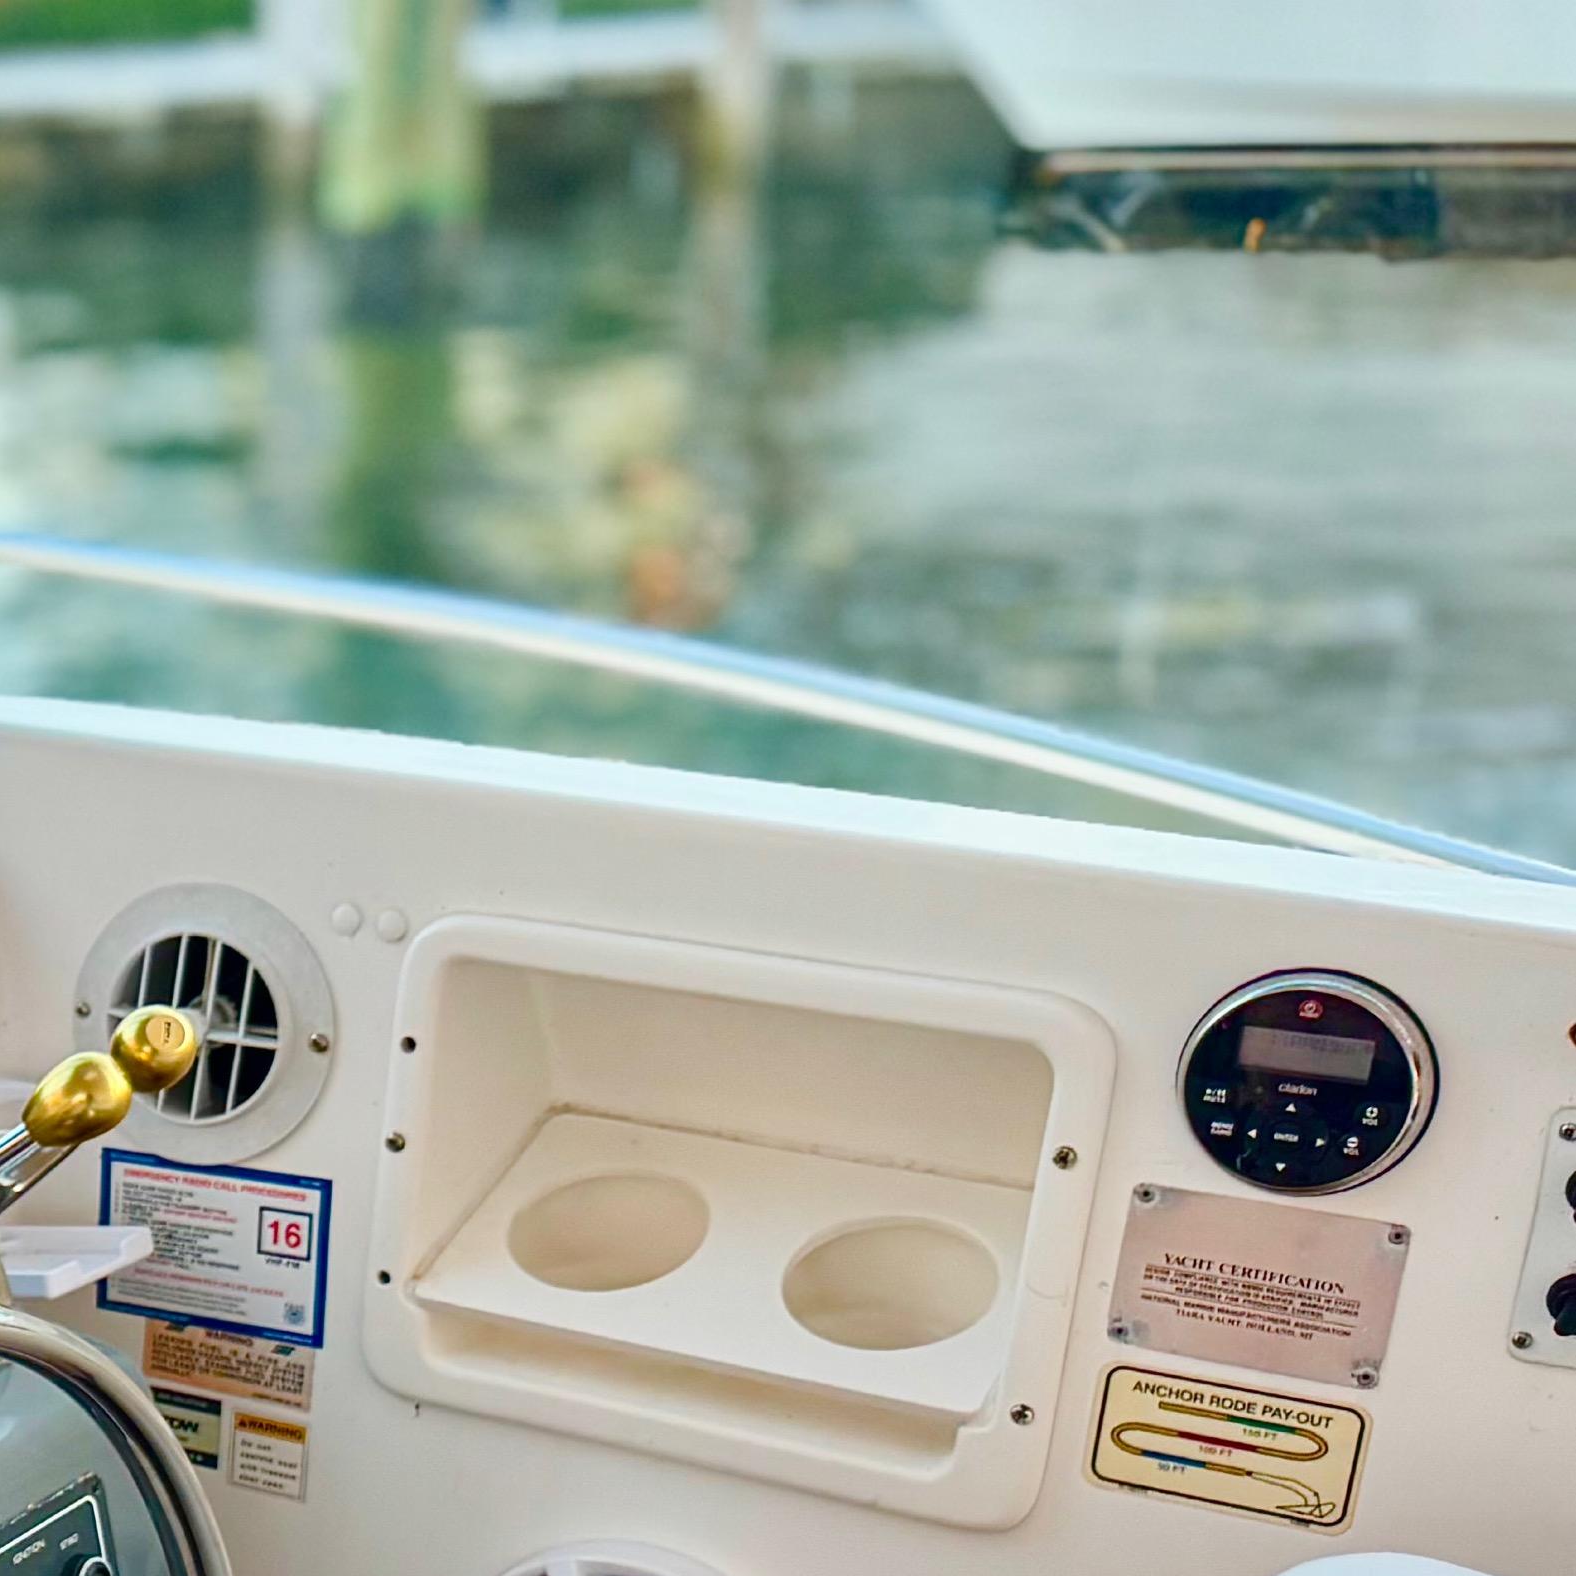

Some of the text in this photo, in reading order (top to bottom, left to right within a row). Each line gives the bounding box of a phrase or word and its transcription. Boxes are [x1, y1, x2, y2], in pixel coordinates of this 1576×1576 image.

[123, 1167, 181, 1185] EMERGENCY
[182, 1175, 212, 1190] RADIO
[213, 1181, 238, 1193] CALL
[240, 1184, 307, 1203] PROCEDURES
[268, 1219, 302, 1249] 16
[1164, 1253, 1345, 1295] YACHT CERTIFICATION
[1133, 1380, 1333, 1429] ANCHOR RODE PAY-OUT
[246, 1419, 303, 1440] WARNING
[1264, 1431, 1279, 1441] FT
[1219, 1448, 1233, 1458] FT
[1172, 1465, 1186, 1474] FT
[12, 1539, 45, 1566] IGNITION
